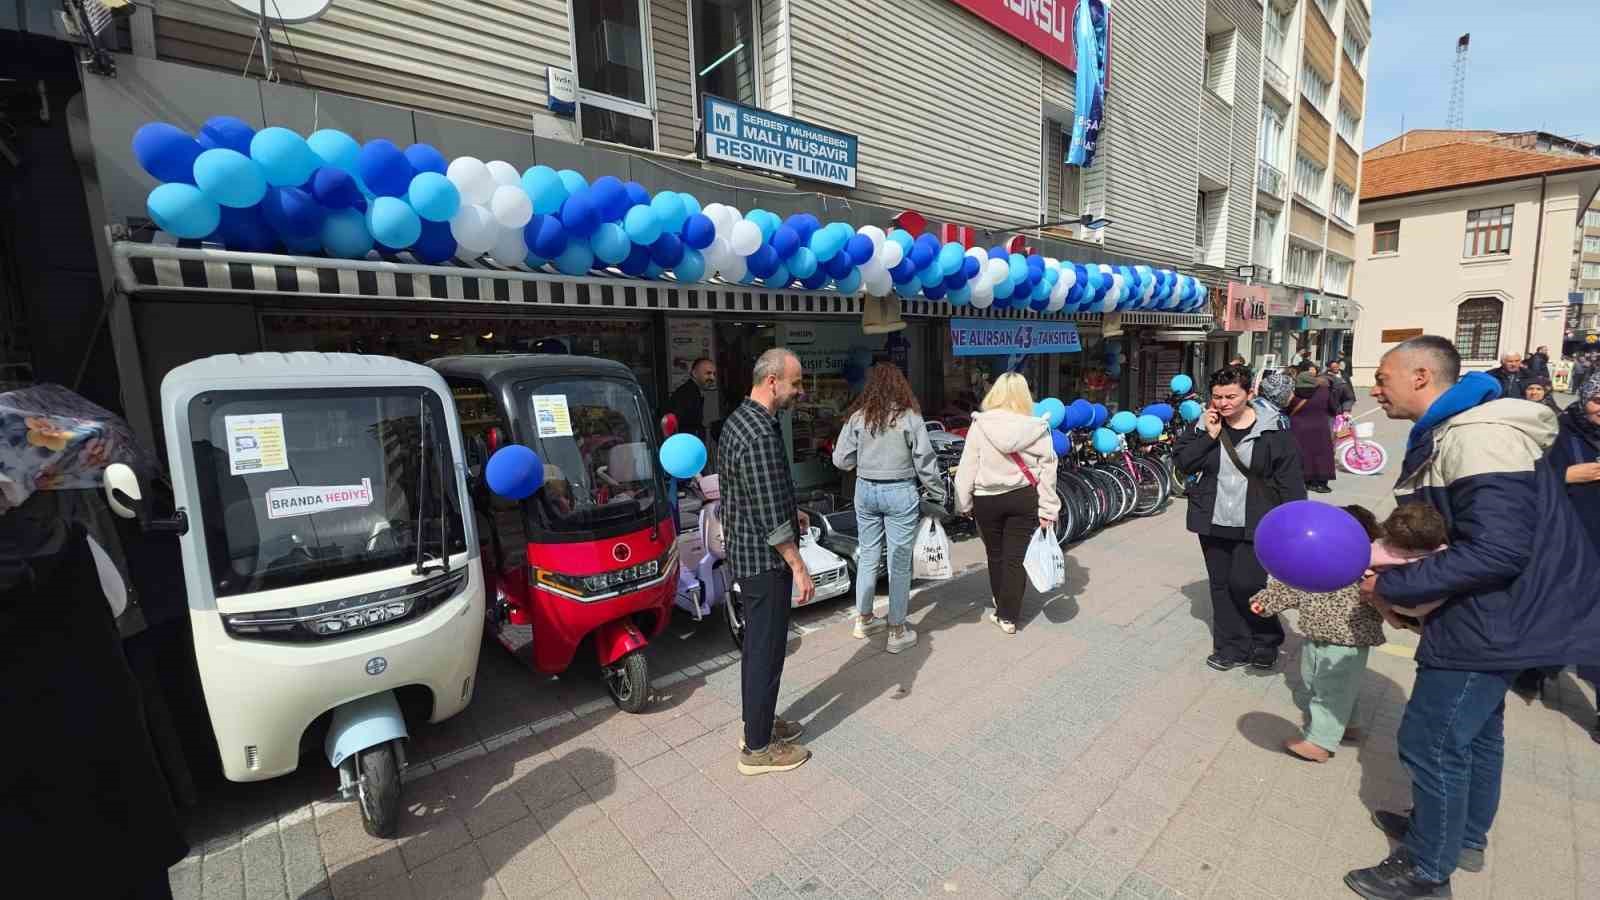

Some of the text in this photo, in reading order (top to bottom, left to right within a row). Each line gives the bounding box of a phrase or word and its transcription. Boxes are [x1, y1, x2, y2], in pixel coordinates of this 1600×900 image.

[1003, 0, 1066, 43] RSU
[743, 113, 788, 132] SERBEST
[743, 126, 848, 163] MALİ MÜŞAVİR
[716, 139, 848, 182] RESMİYE ILIMAN
[952, 329, 967, 346] NE
[969, 329, 1012, 346] ALIRSAN
[1014, 325, 1033, 349] 43
[271, 495, 323, 510] BRANDA
